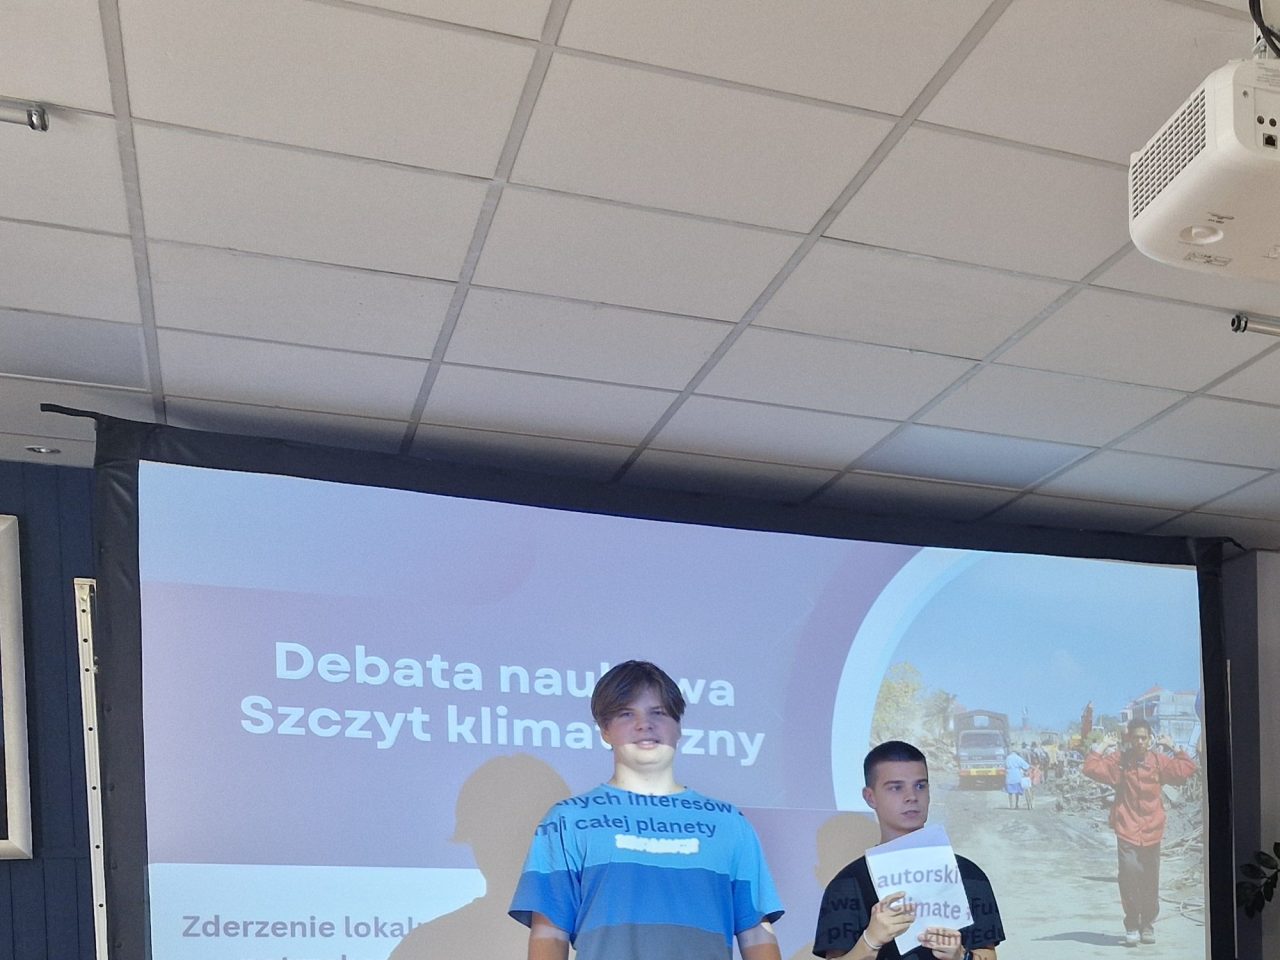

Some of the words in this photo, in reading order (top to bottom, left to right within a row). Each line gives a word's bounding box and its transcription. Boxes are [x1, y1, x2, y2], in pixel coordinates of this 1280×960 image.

[275, 641, 484, 691] Debata
[240, 695, 432, 750] Szczyt
[574, 814, 630, 833] całej
[636, 818, 716, 838] planety
[181, 915, 336, 938] Zderzenie
